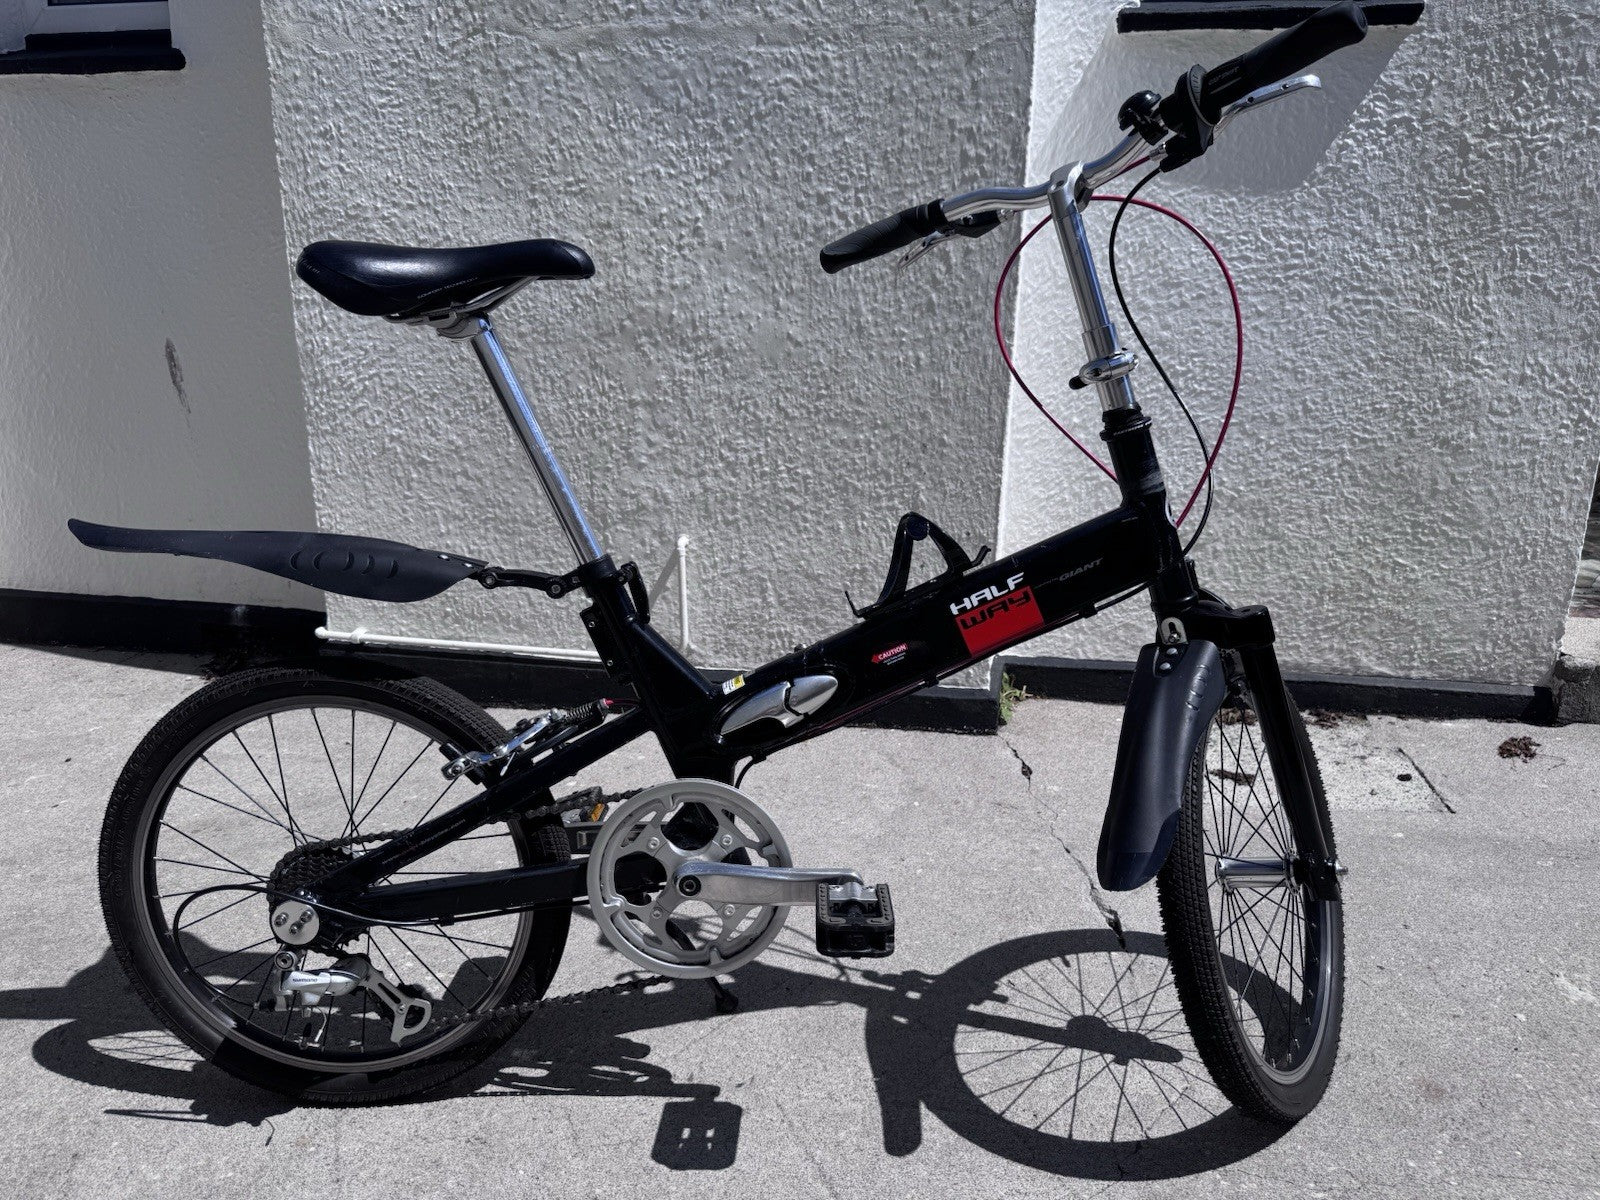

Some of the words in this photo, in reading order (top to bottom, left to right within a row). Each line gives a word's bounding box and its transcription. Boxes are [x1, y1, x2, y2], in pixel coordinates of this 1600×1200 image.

[1059, 557, 1104, 582] GIANT
[950, 571, 1024, 616] HALF
[960, 591, 1031, 630] WAY
[878, 643, 907, 660] CAUTION
